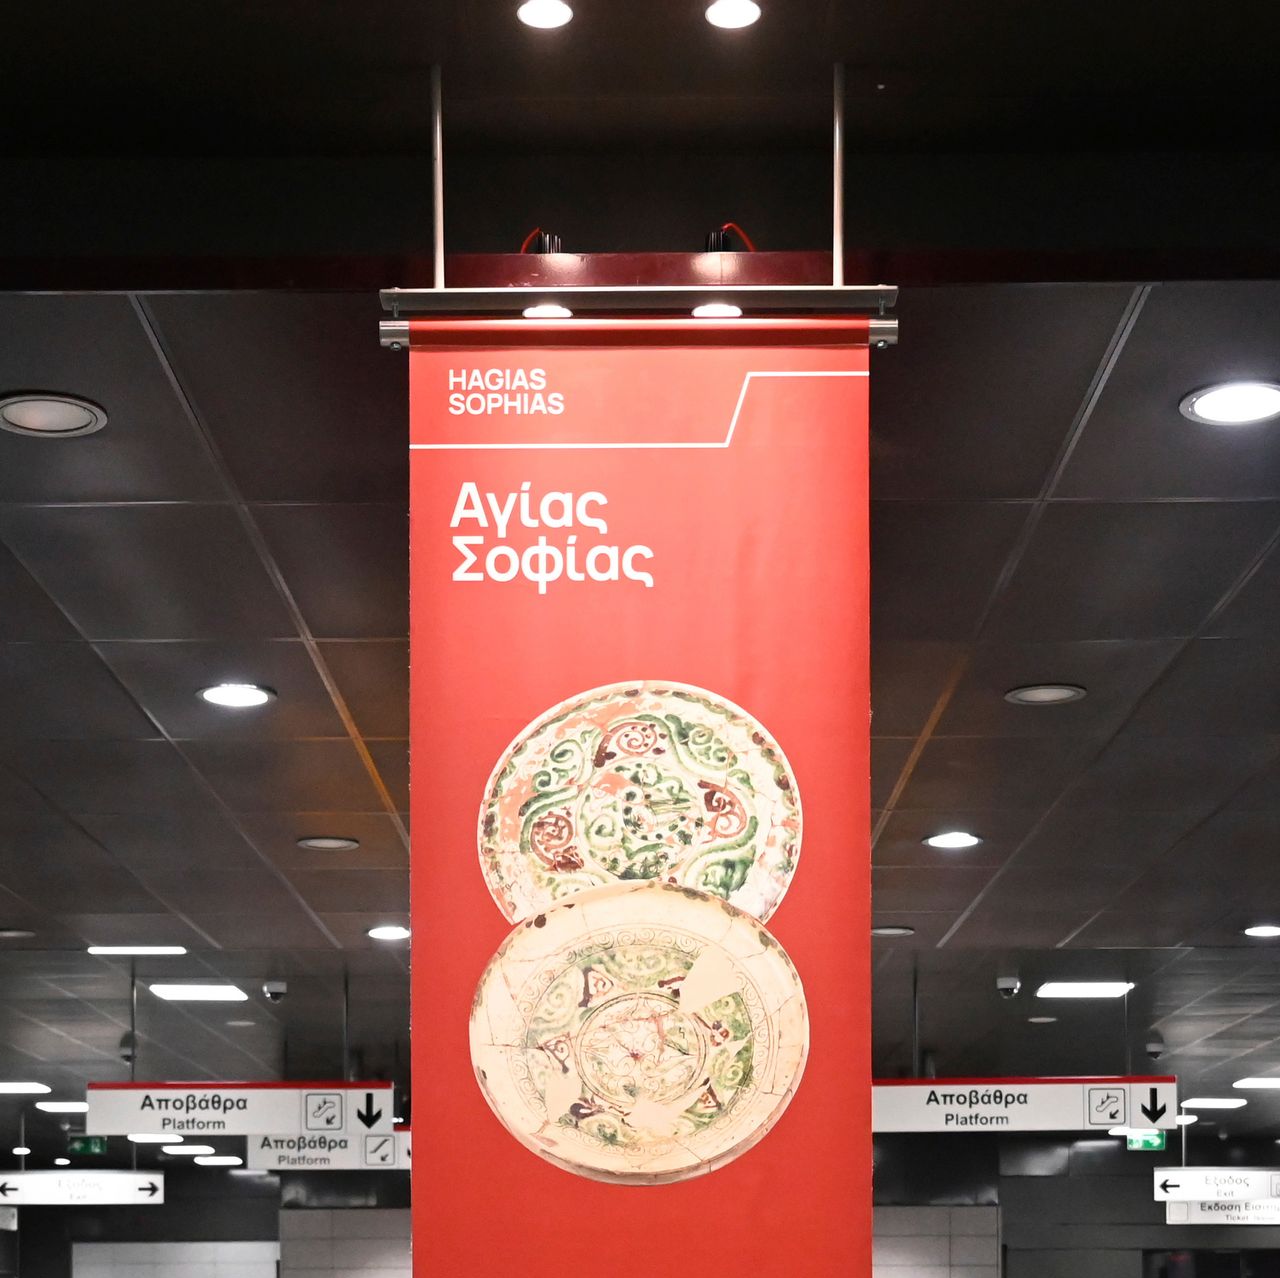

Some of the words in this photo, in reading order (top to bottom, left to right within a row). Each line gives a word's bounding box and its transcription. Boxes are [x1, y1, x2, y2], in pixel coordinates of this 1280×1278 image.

[448, 367, 547, 391] HAGIAS
[448, 392, 565, 415] SOPHIAS
[449, 481, 609, 538] Αγίας
[451, 535, 655, 595] Σοφίας
[140, 1093, 248, 1114] Αποβάθρα
[925, 1089, 1028, 1109] Αποβάθρα
[161, 1117, 226, 1130] Platform
[944, 1113, 1009, 1126] Platform
[260, 1135, 348, 1153] Αποβάθρα
[277, 1154, 331, 1166] Platform
